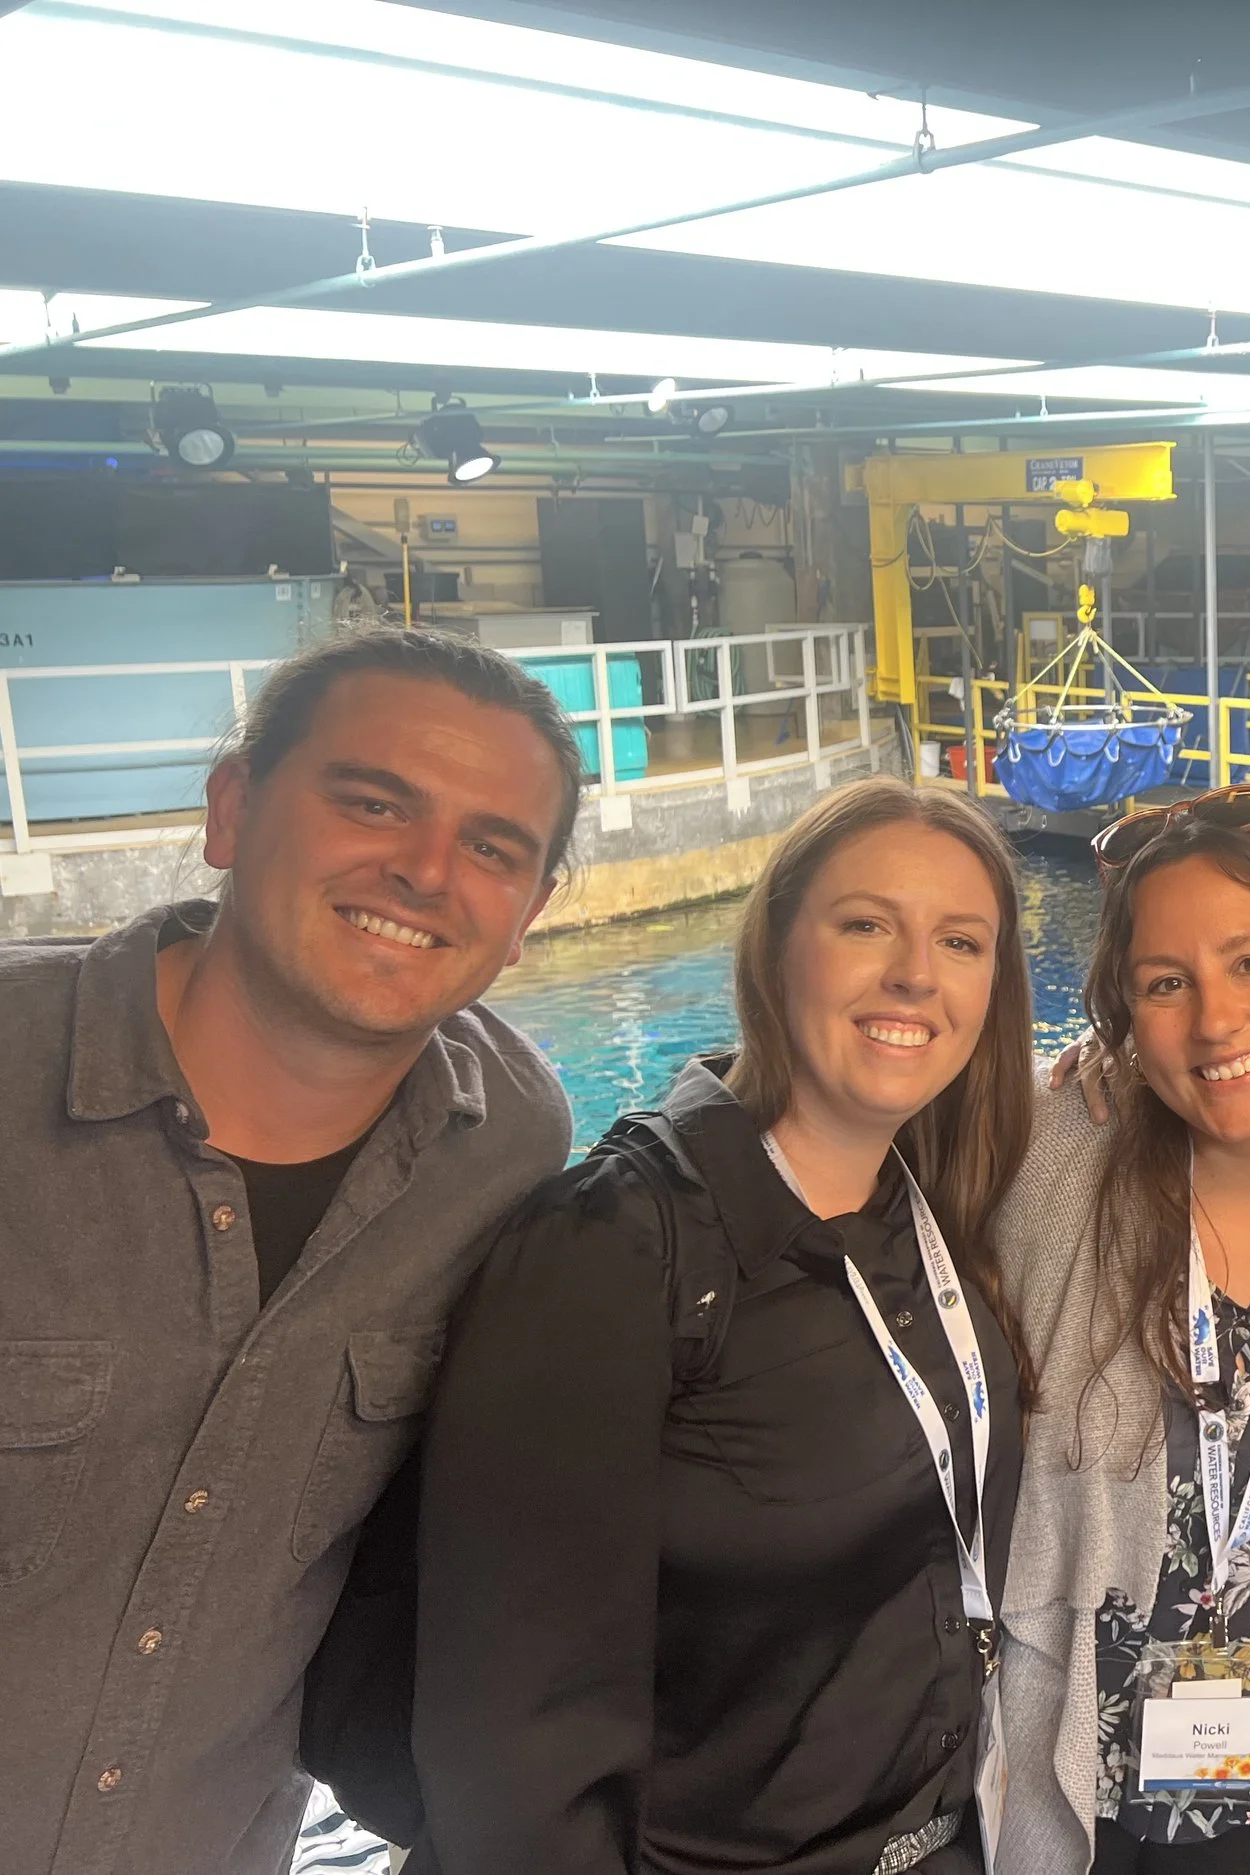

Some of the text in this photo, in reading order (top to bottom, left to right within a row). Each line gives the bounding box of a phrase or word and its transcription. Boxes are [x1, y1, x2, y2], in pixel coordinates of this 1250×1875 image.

[933, 1250, 951, 1287] WATER
[971, 1352, 981, 1379] WATER
[1194, 1347, 1202, 1376] WATER
[1200, 1346, 1208, 1364] OUR
[1207, 1346, 1215, 1367] SAVE
[905, 1381, 921, 1410] WATER
[911, 1376, 925, 1396] SAVE
[1207, 1444, 1221, 1542] WATER RESOURCES
[1192, 1723, 1230, 1735] Nicki
[1193, 1740, 1228, 1750] Powell
